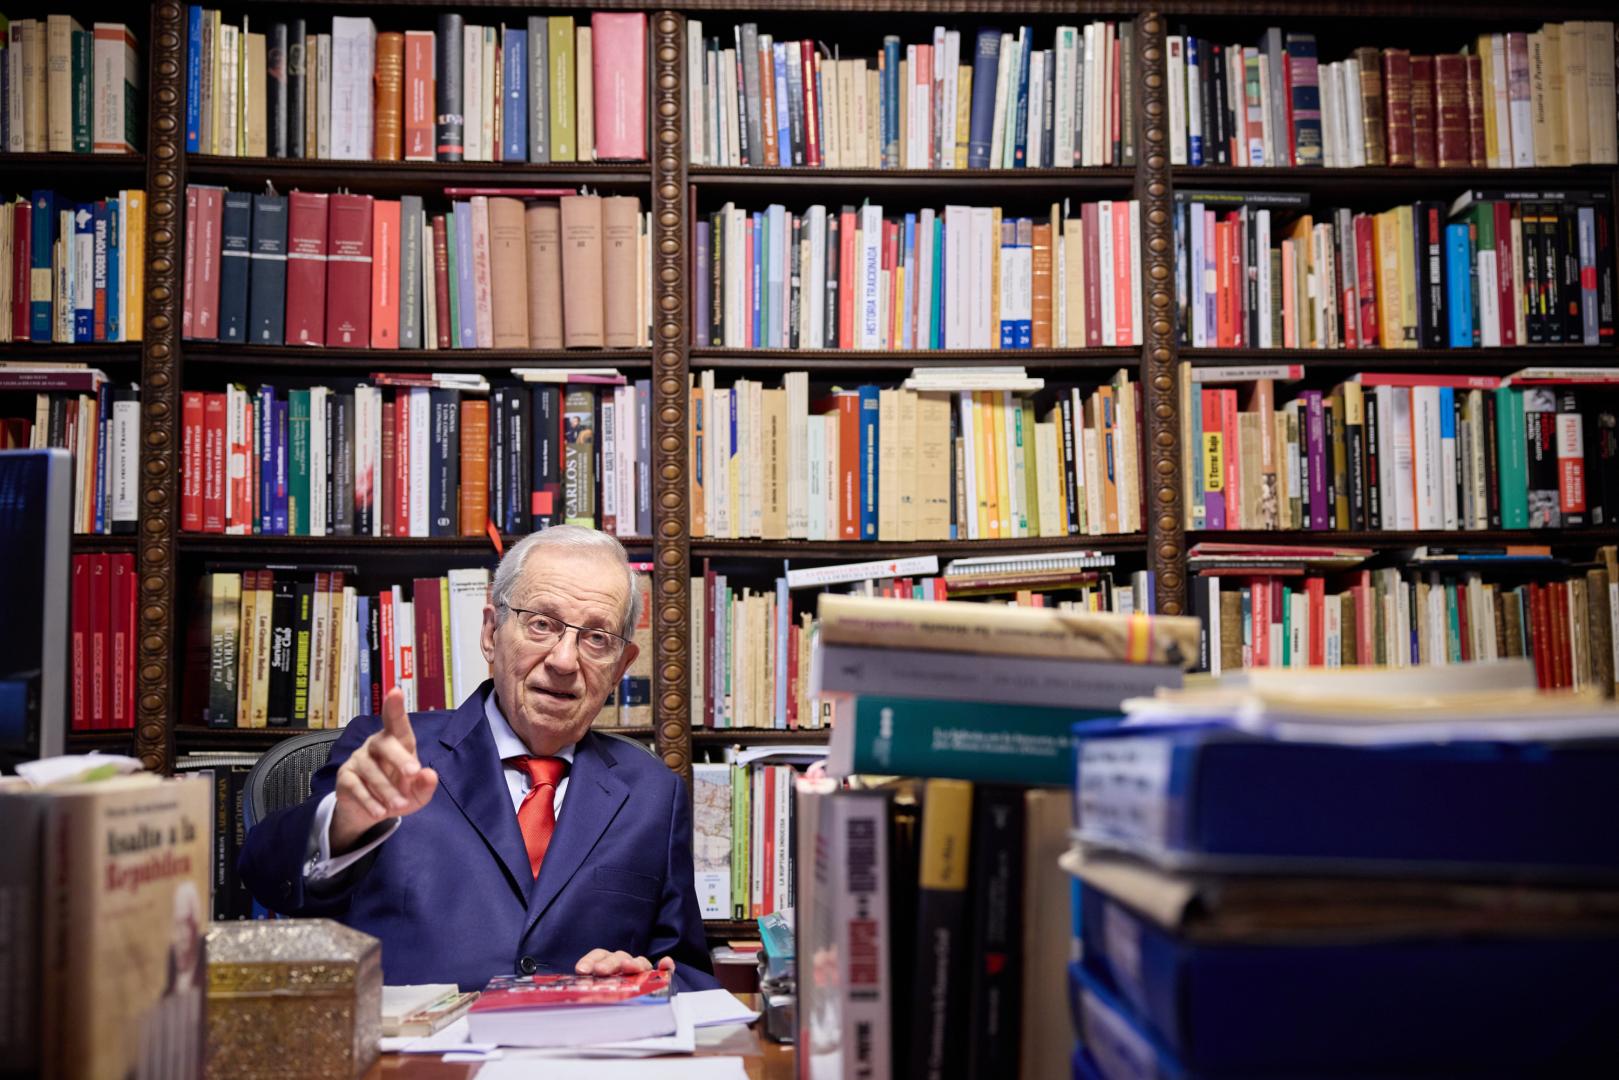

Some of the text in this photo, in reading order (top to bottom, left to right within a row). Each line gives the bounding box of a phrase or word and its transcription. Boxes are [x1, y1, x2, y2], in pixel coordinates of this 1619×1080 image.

[866, 246, 877, 336] HISTORIA TRAICIONADA
[1209, 436, 1218, 453] Rojo
[566, 446, 577, 518] CARLOS V
[1209, 456, 1218, 477] Terror
[95, 565, 103, 576] 2
[214, 634, 222, 669] LUGAR
[224, 625, 234, 666] VOLVER
[272, 627, 282, 667] Survivor's
[282, 627, 291, 647] Club
[107, 816, 196, 857] Asalto a la
[104, 855, 192, 897] República
